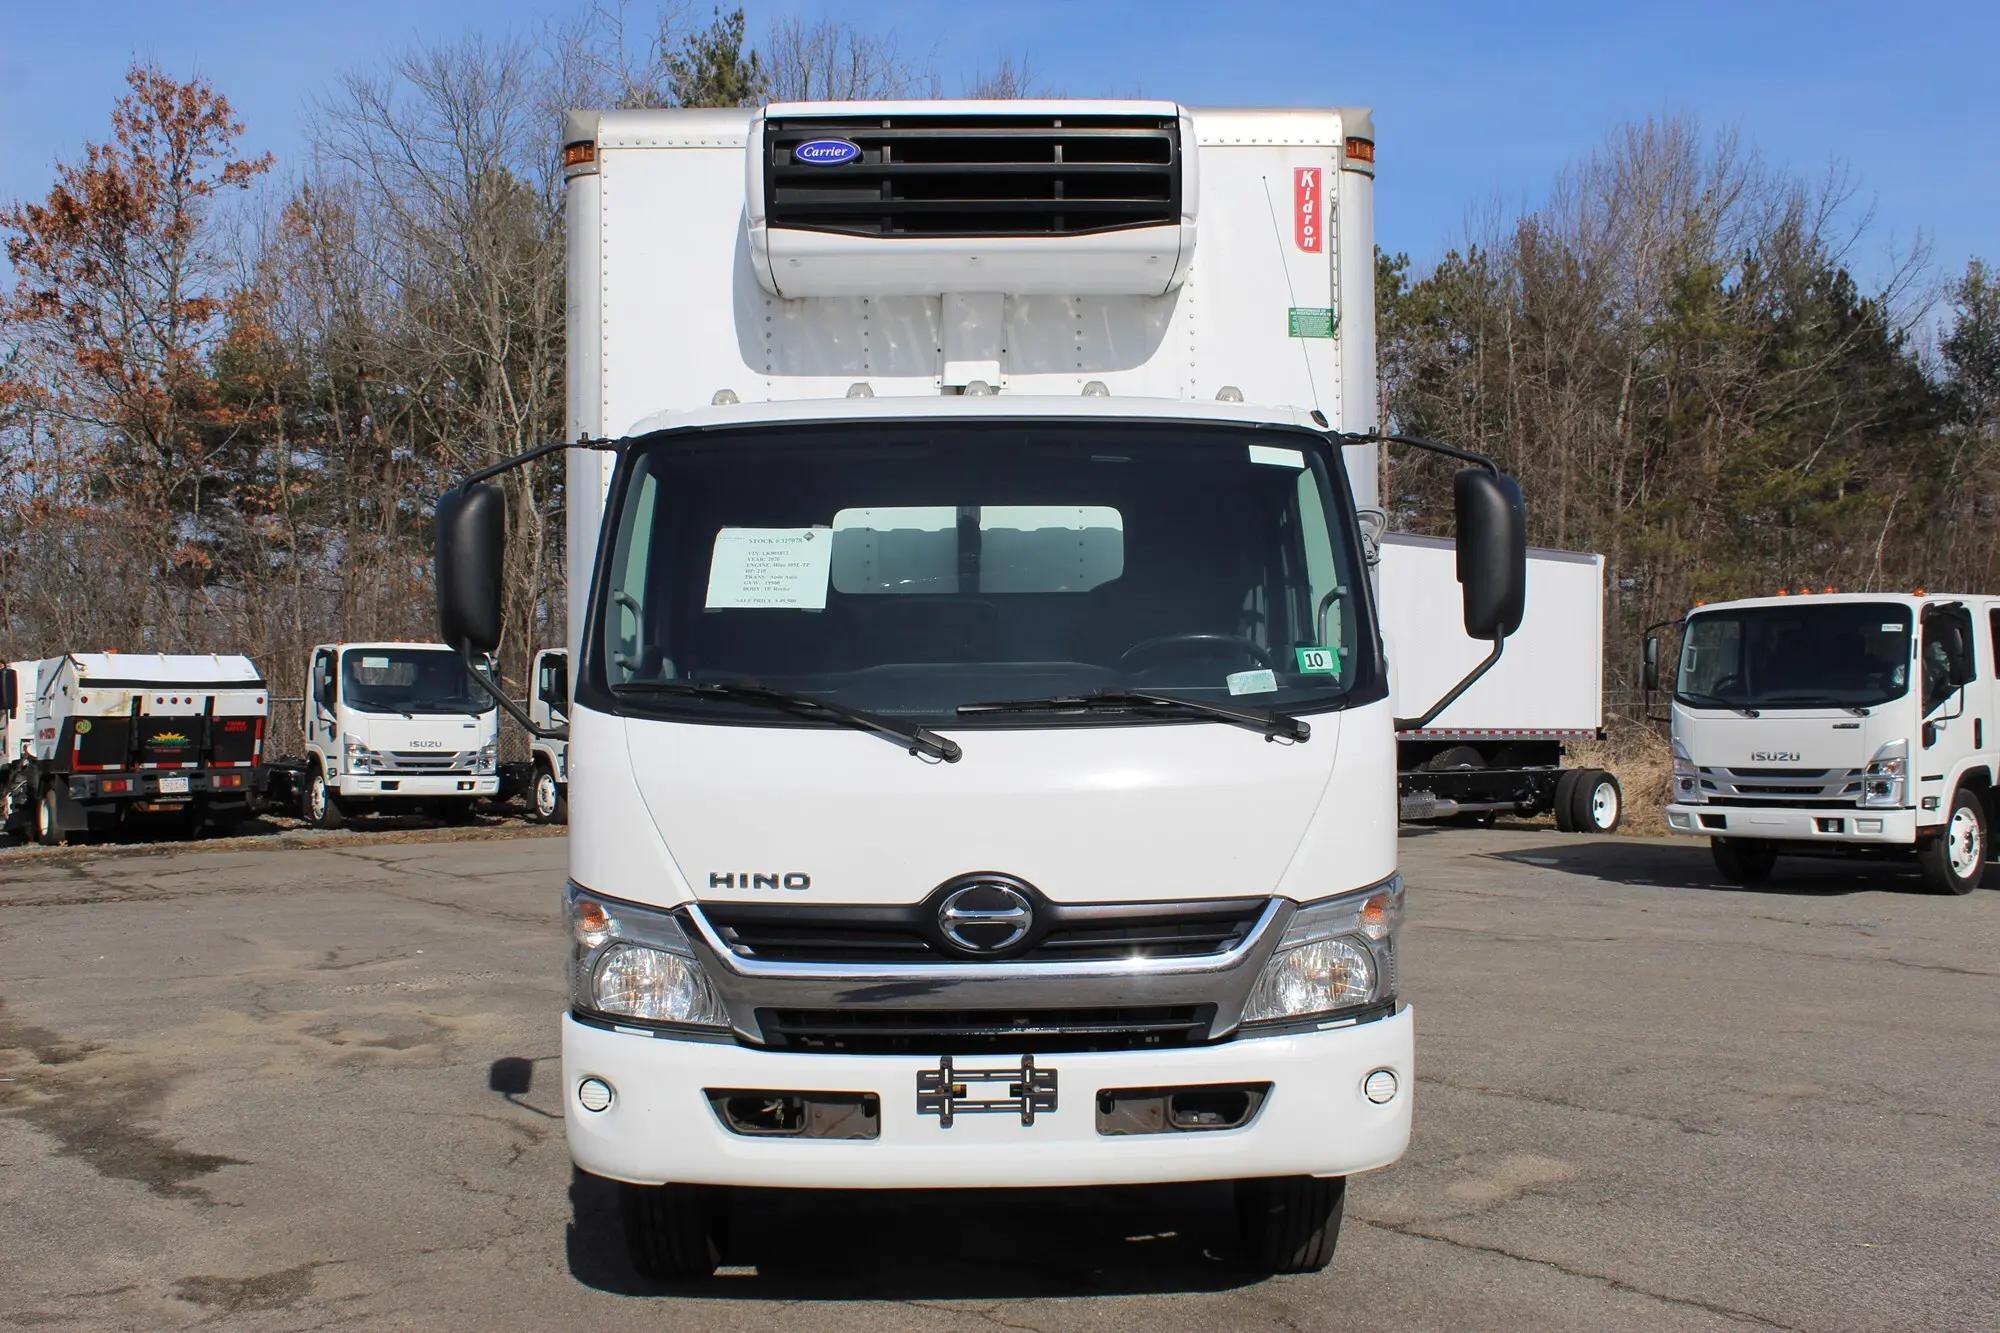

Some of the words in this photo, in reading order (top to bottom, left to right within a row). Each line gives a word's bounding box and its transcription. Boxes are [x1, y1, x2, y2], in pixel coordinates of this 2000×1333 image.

[803, 146, 848, 157] Carrier
[1301, 170, 1315, 248] Kidron
[1305, 652, 1323, 668] 10
[409, 740, 442, 748] ISUZU
[1751, 751, 1801, 762] ISUZU
[709, 872, 811, 890] HINO
